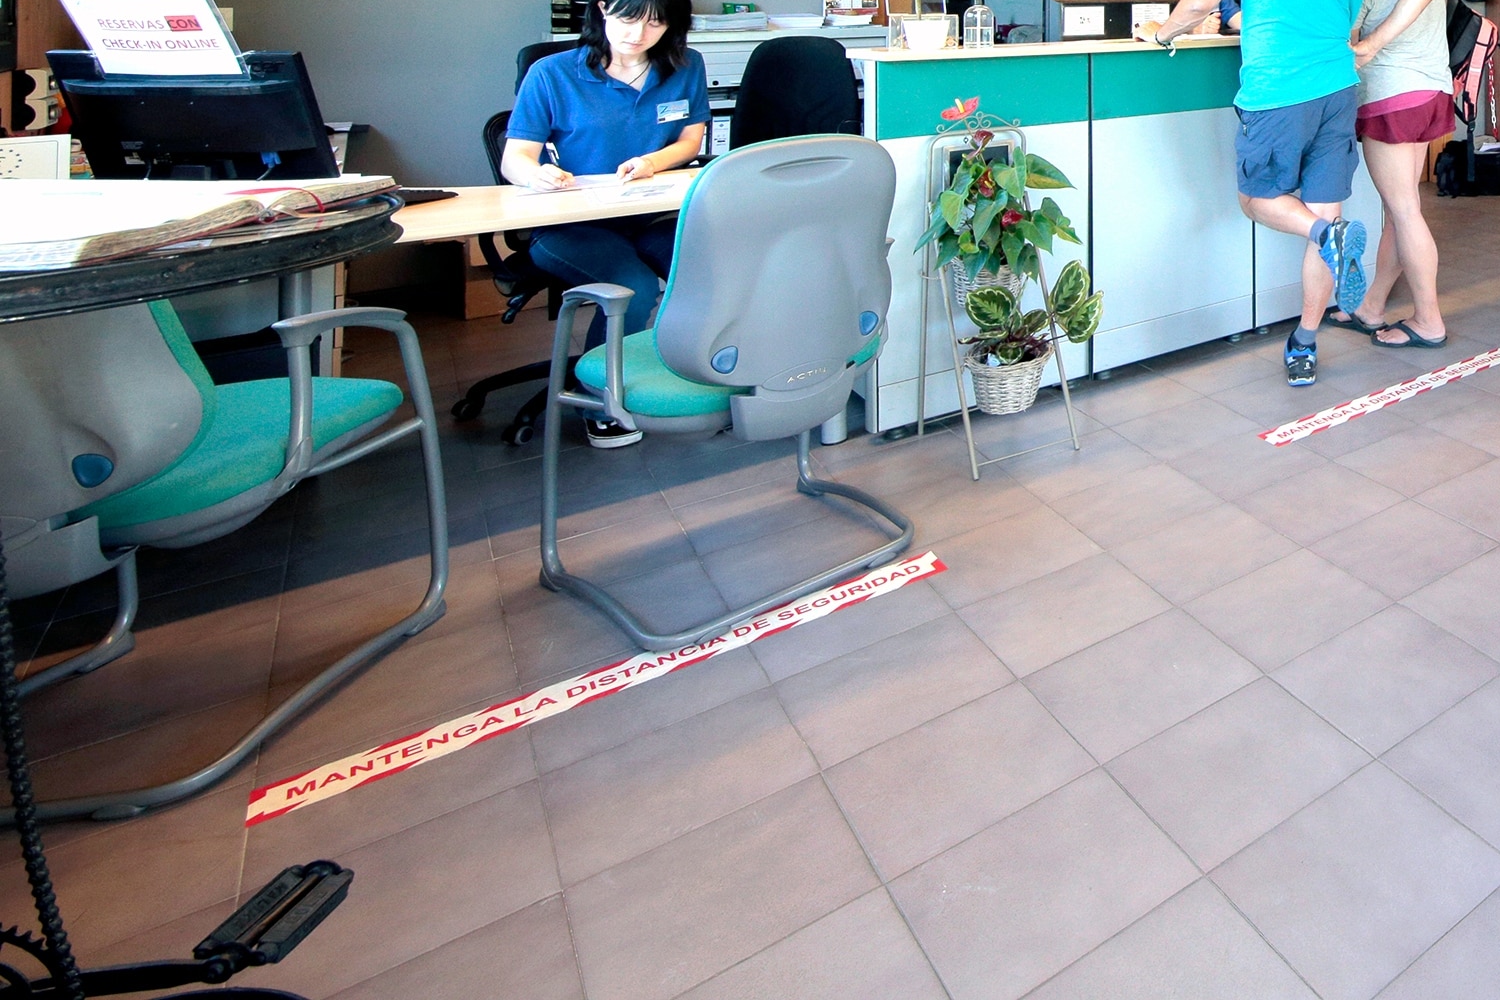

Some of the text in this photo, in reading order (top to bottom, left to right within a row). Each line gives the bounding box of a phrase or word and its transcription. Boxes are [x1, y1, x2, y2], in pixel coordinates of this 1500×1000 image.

[97, 18, 199, 30] RESERVAS CON
[102, 38, 220, 49] CHECK-IN ONLINE
[1277, 410, 1352, 439] MANTENGA
[1351, 400, 1369, 412] LA
[1368, 380, 1427, 406] DISTANCIA
[1428, 374, 1444, 384] DE
[285, 563, 922, 801] MANTENGA LA DISTANCIA DE SEGURIDAD
